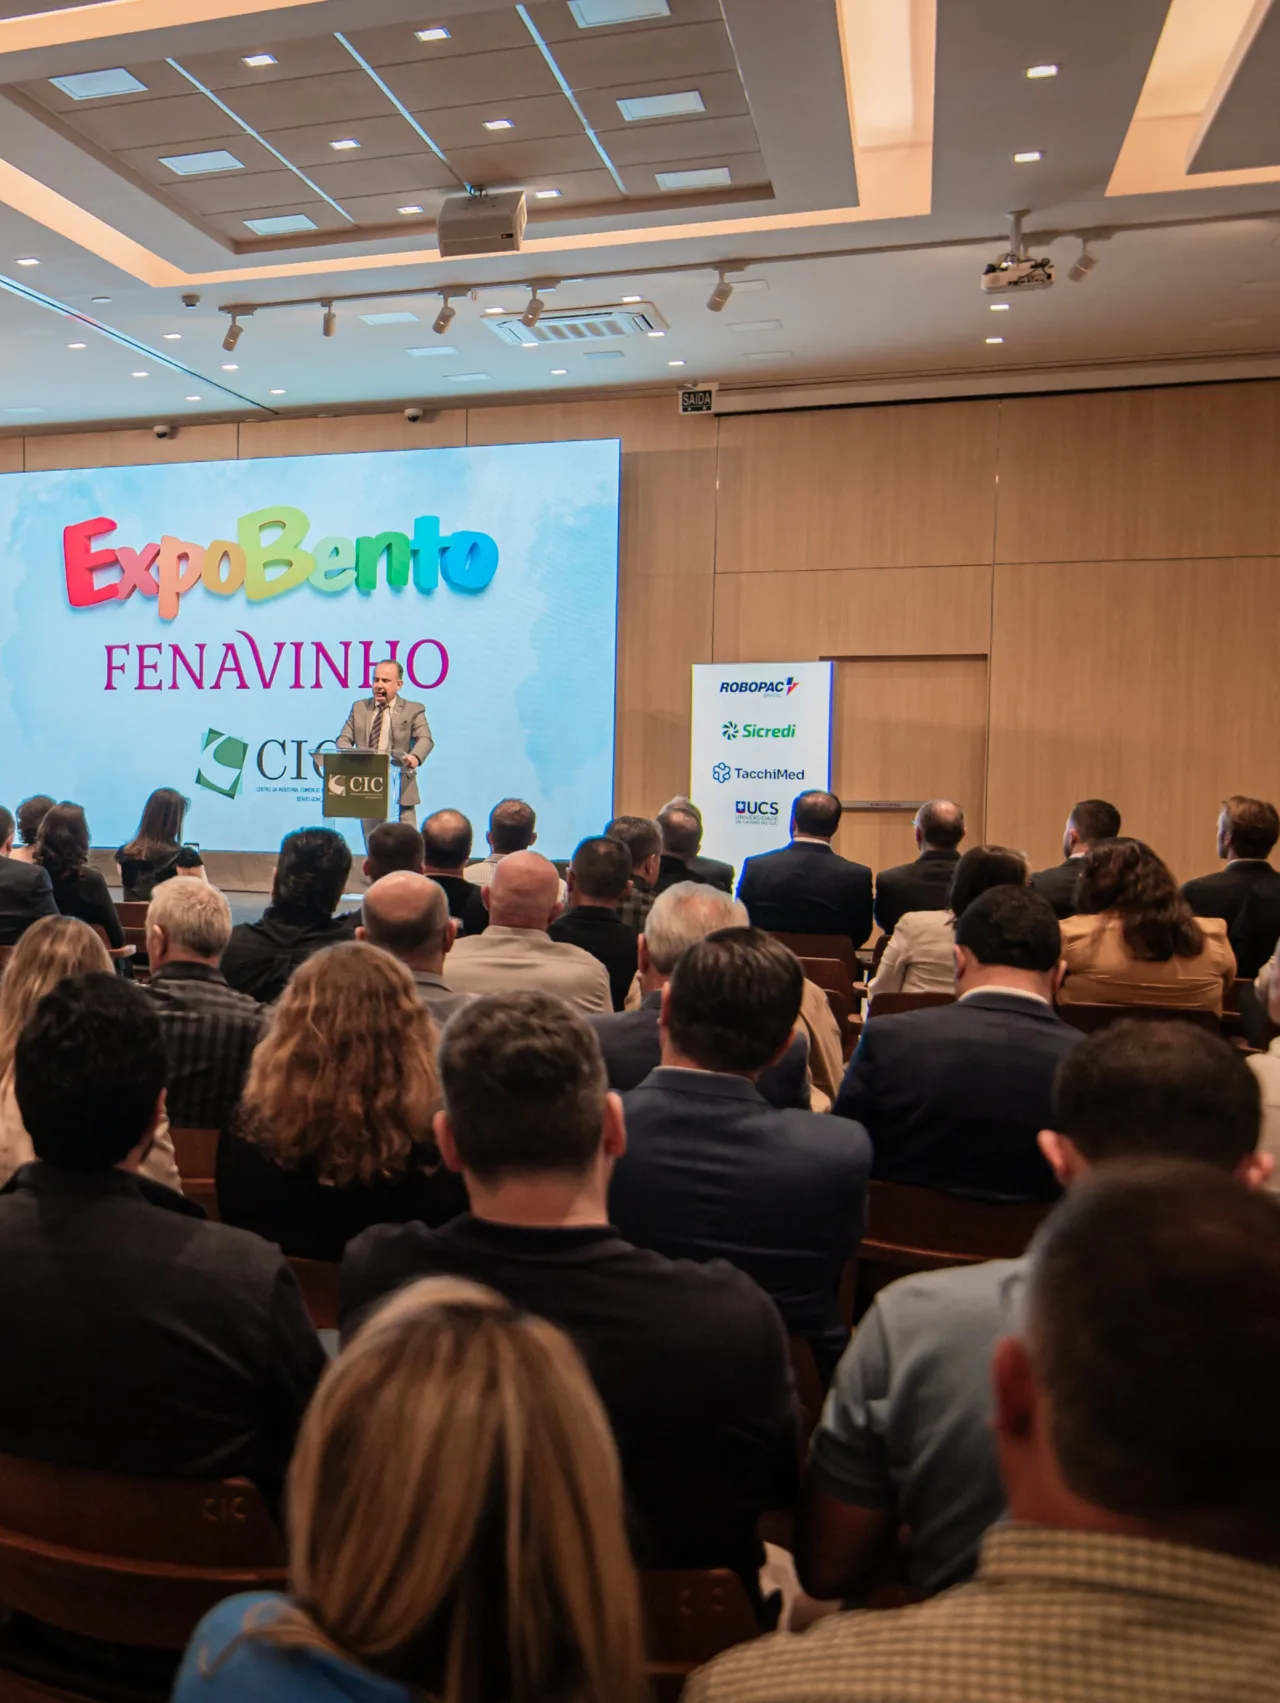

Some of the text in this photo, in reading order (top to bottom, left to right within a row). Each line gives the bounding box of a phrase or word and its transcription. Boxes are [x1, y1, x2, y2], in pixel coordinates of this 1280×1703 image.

[63, 505, 499, 620] ExpoBento
[104, 629, 450, 691] FENAVINHO
[719, 681, 785, 693] ROBOPAC
[742, 724, 796, 738] Sicredi
[734, 767, 805, 781] TacchiMed
[349, 776, 384, 792] CIC
[747, 801, 779, 815] UCS
